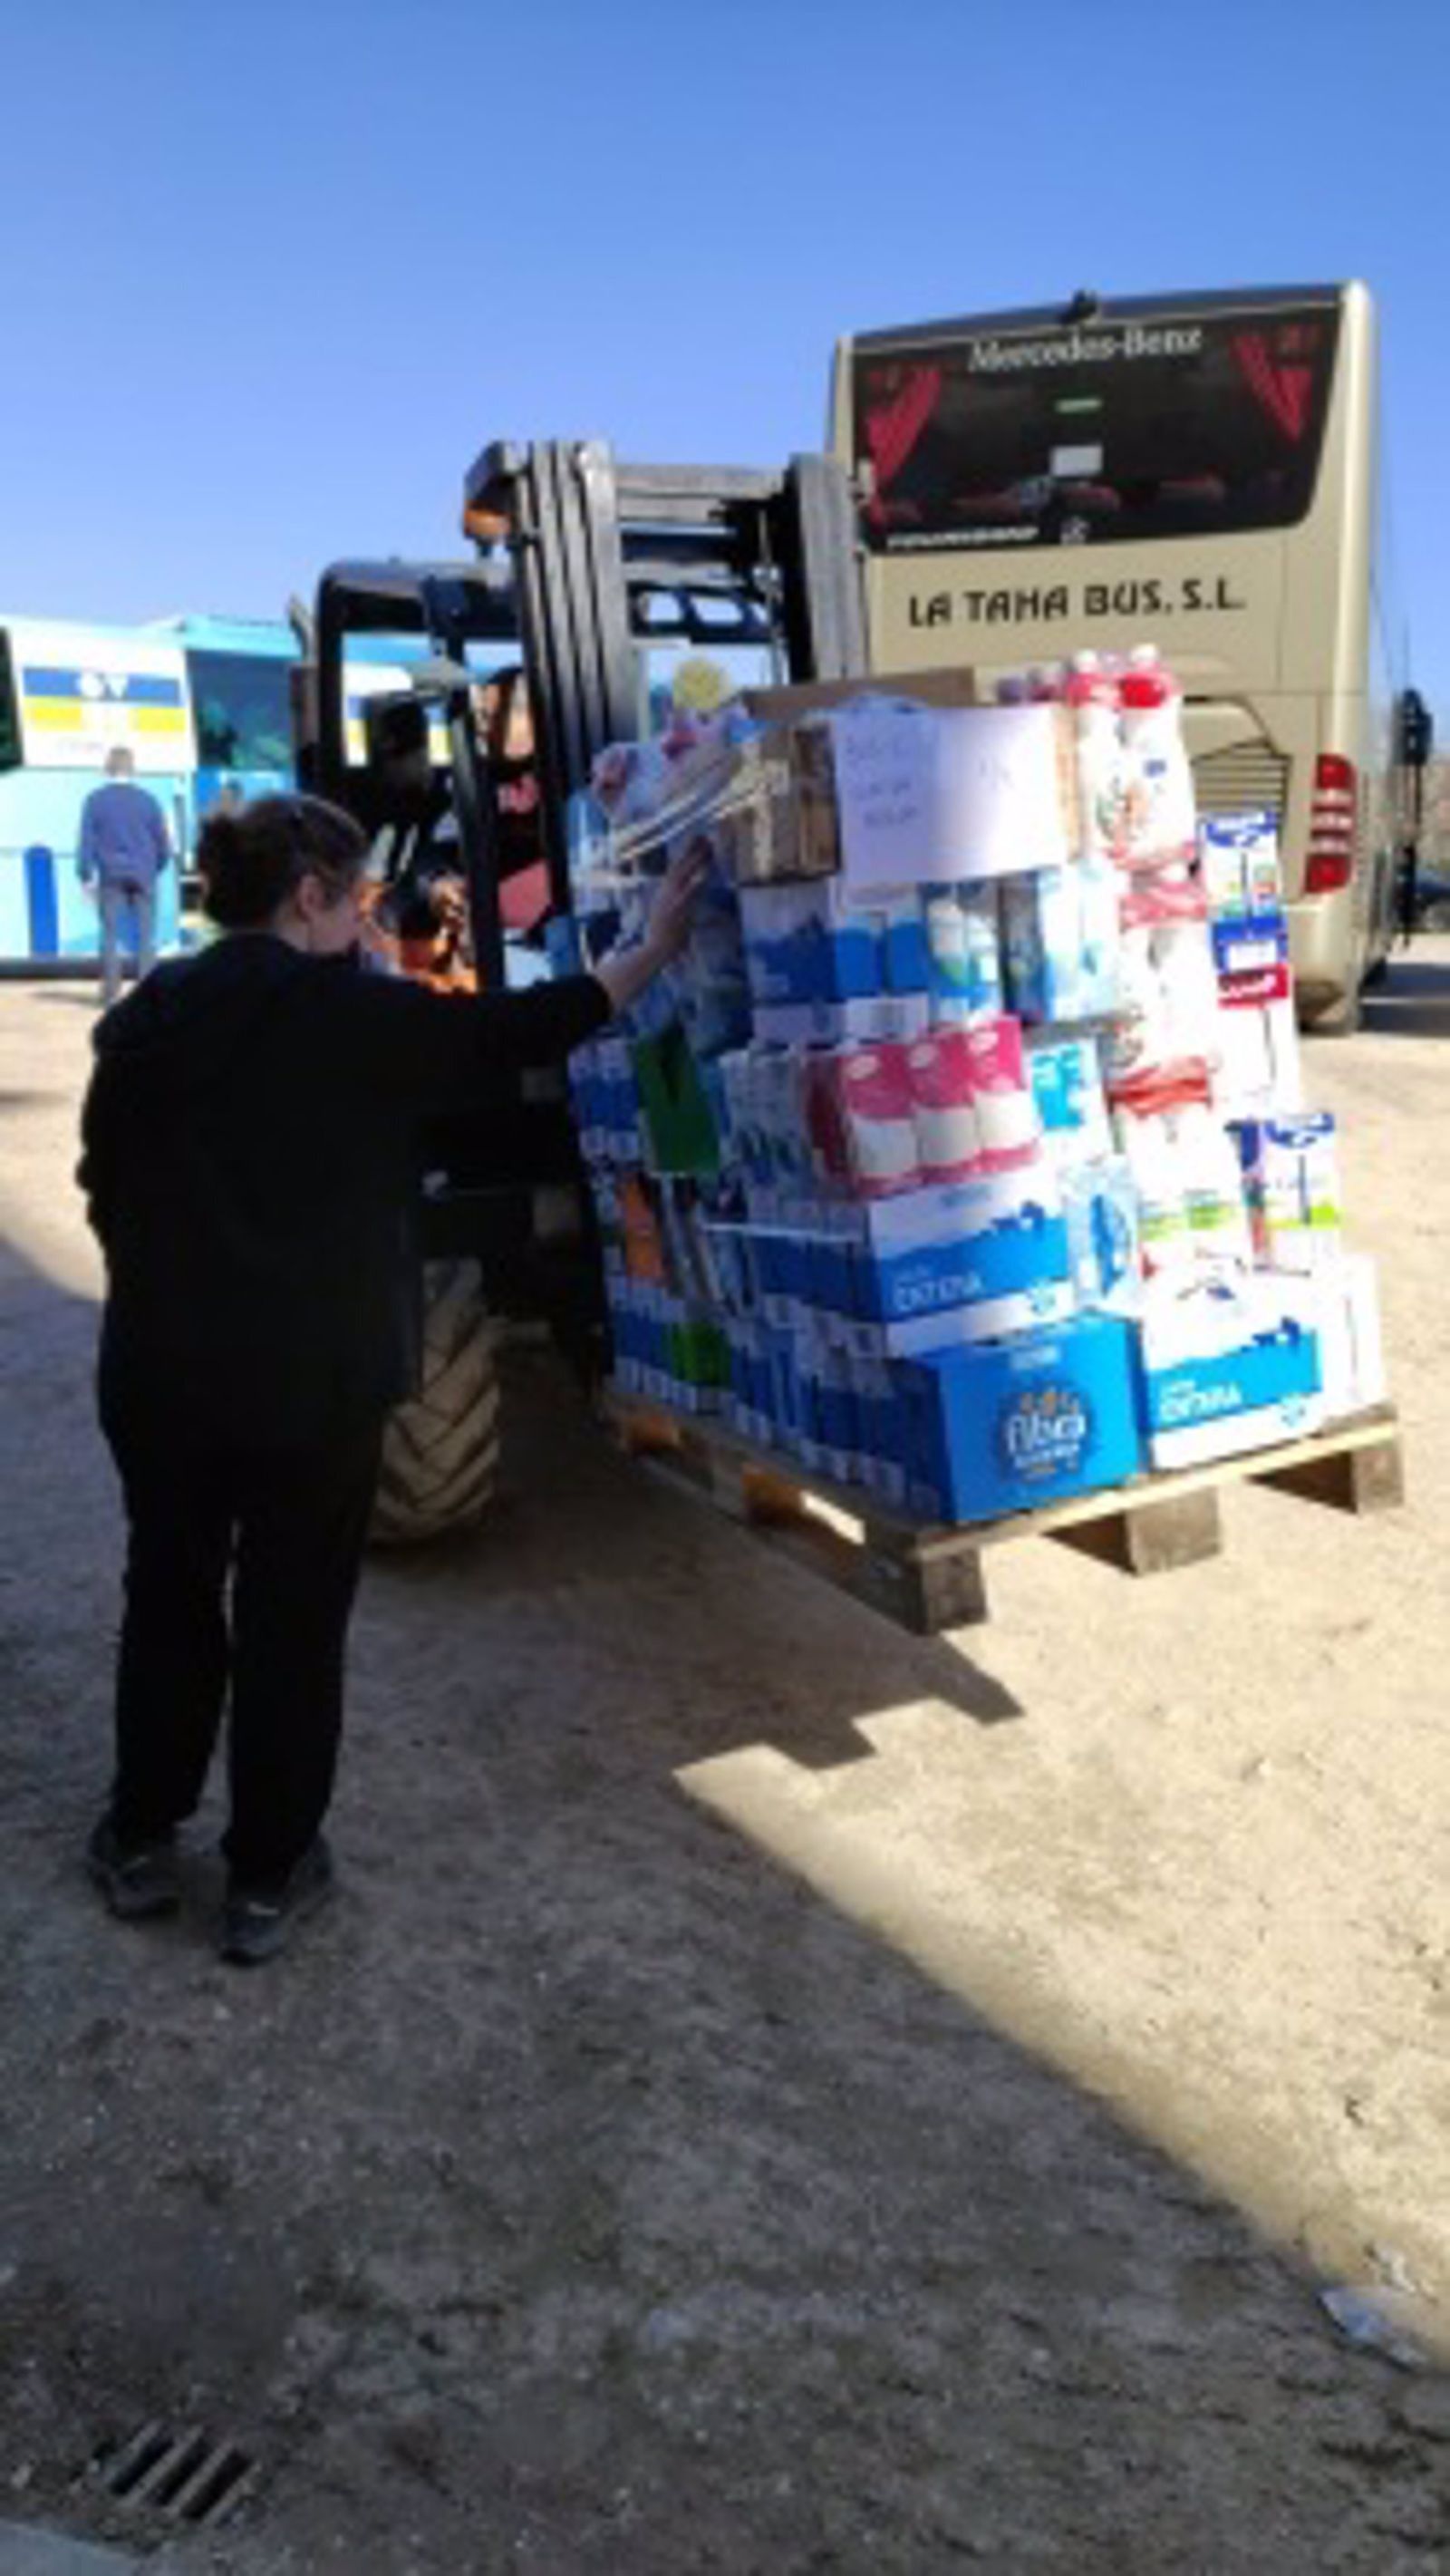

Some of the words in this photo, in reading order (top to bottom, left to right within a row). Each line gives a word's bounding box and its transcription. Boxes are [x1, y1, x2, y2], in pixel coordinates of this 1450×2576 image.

[968, 325, 1202, 373] Mercedes-Benz
[909, 593, 951, 628] LA
[963, 585, 1069, 623] TAHA
